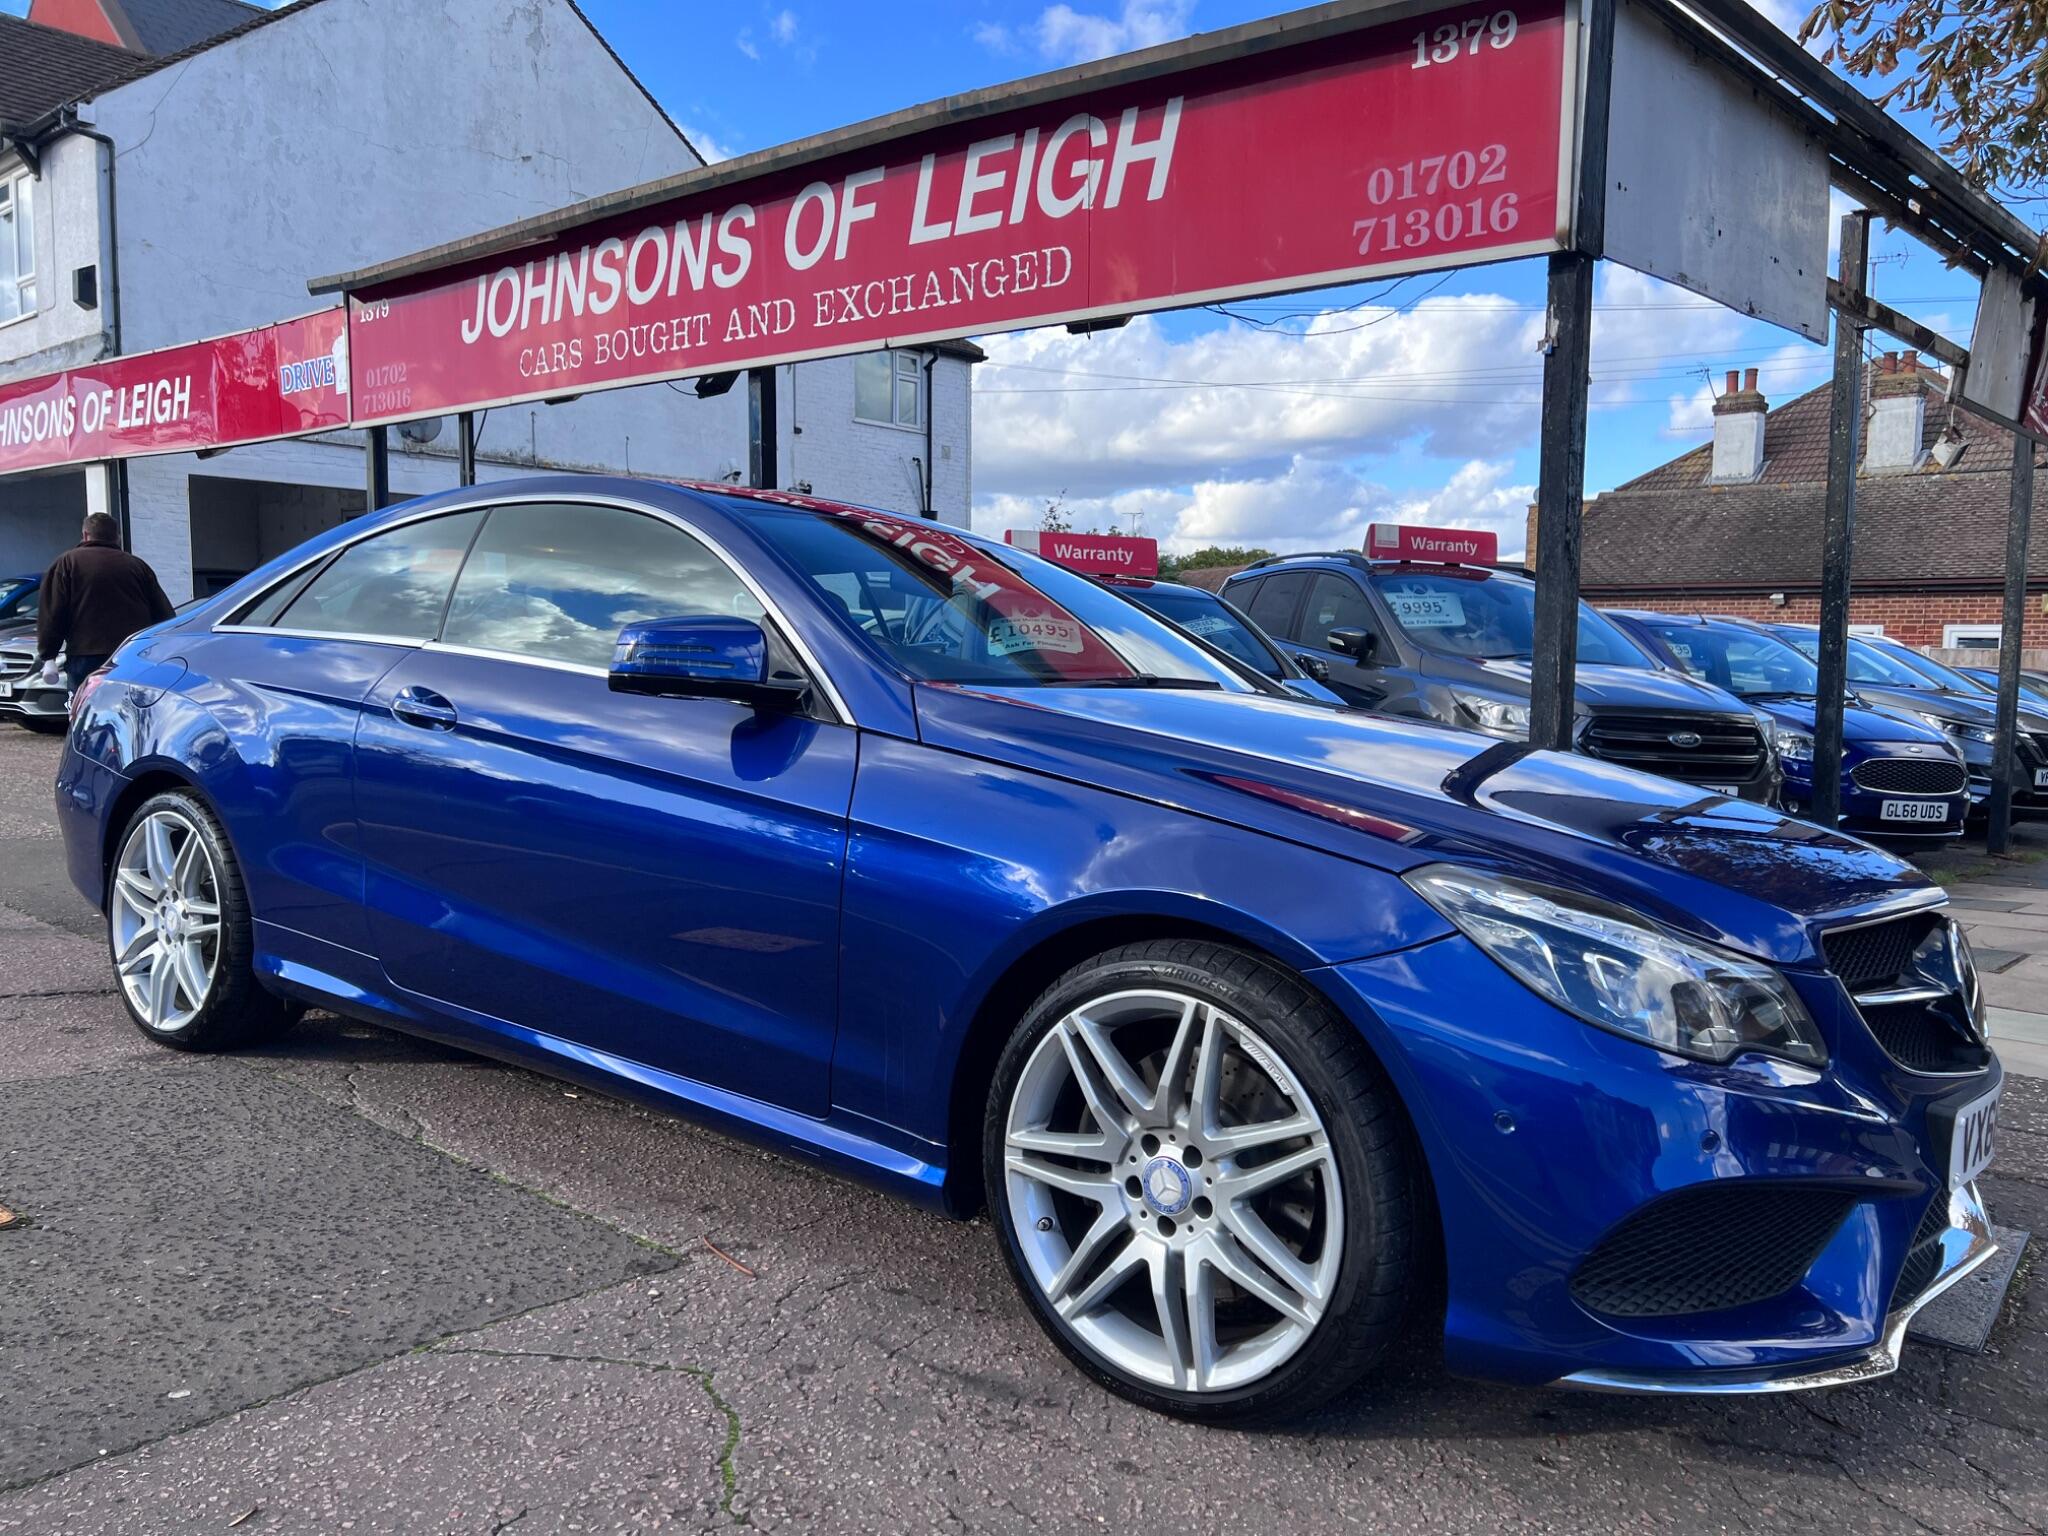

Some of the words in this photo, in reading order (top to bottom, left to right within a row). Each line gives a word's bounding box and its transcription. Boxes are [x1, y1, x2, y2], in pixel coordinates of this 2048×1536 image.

[1411, 9, 1519, 70] 1379
[1367, 143, 1507, 205] 01702
[460, 203, 756, 344] JOHNSONS
[784, 165, 886, 271] OF
[909, 95, 1185, 244] LEIGH
[1353, 192, 1519, 256] 713016
[519, 334, 583, 378] CARS
[594, 312, 712, 366] BOUGHT
[723, 298, 796, 341] AND
[813, 245, 1073, 328] EXCHANGED
[82, 389, 114, 434] OF
[118, 375, 191, 429] LEIGH
[280, 355, 334, 395] DRIVE
[363, 388, 412, 414] 713016
[366, 362, 408, 389] 01702
[1054, 543, 1134, 565] Warranty
[1411, 536, 1478, 556] Warranty
[1886, 803, 1918, 818] GL68
[1920, 804, 1944, 819] UDS
[1963, 1099, 1998, 1174] VX6
